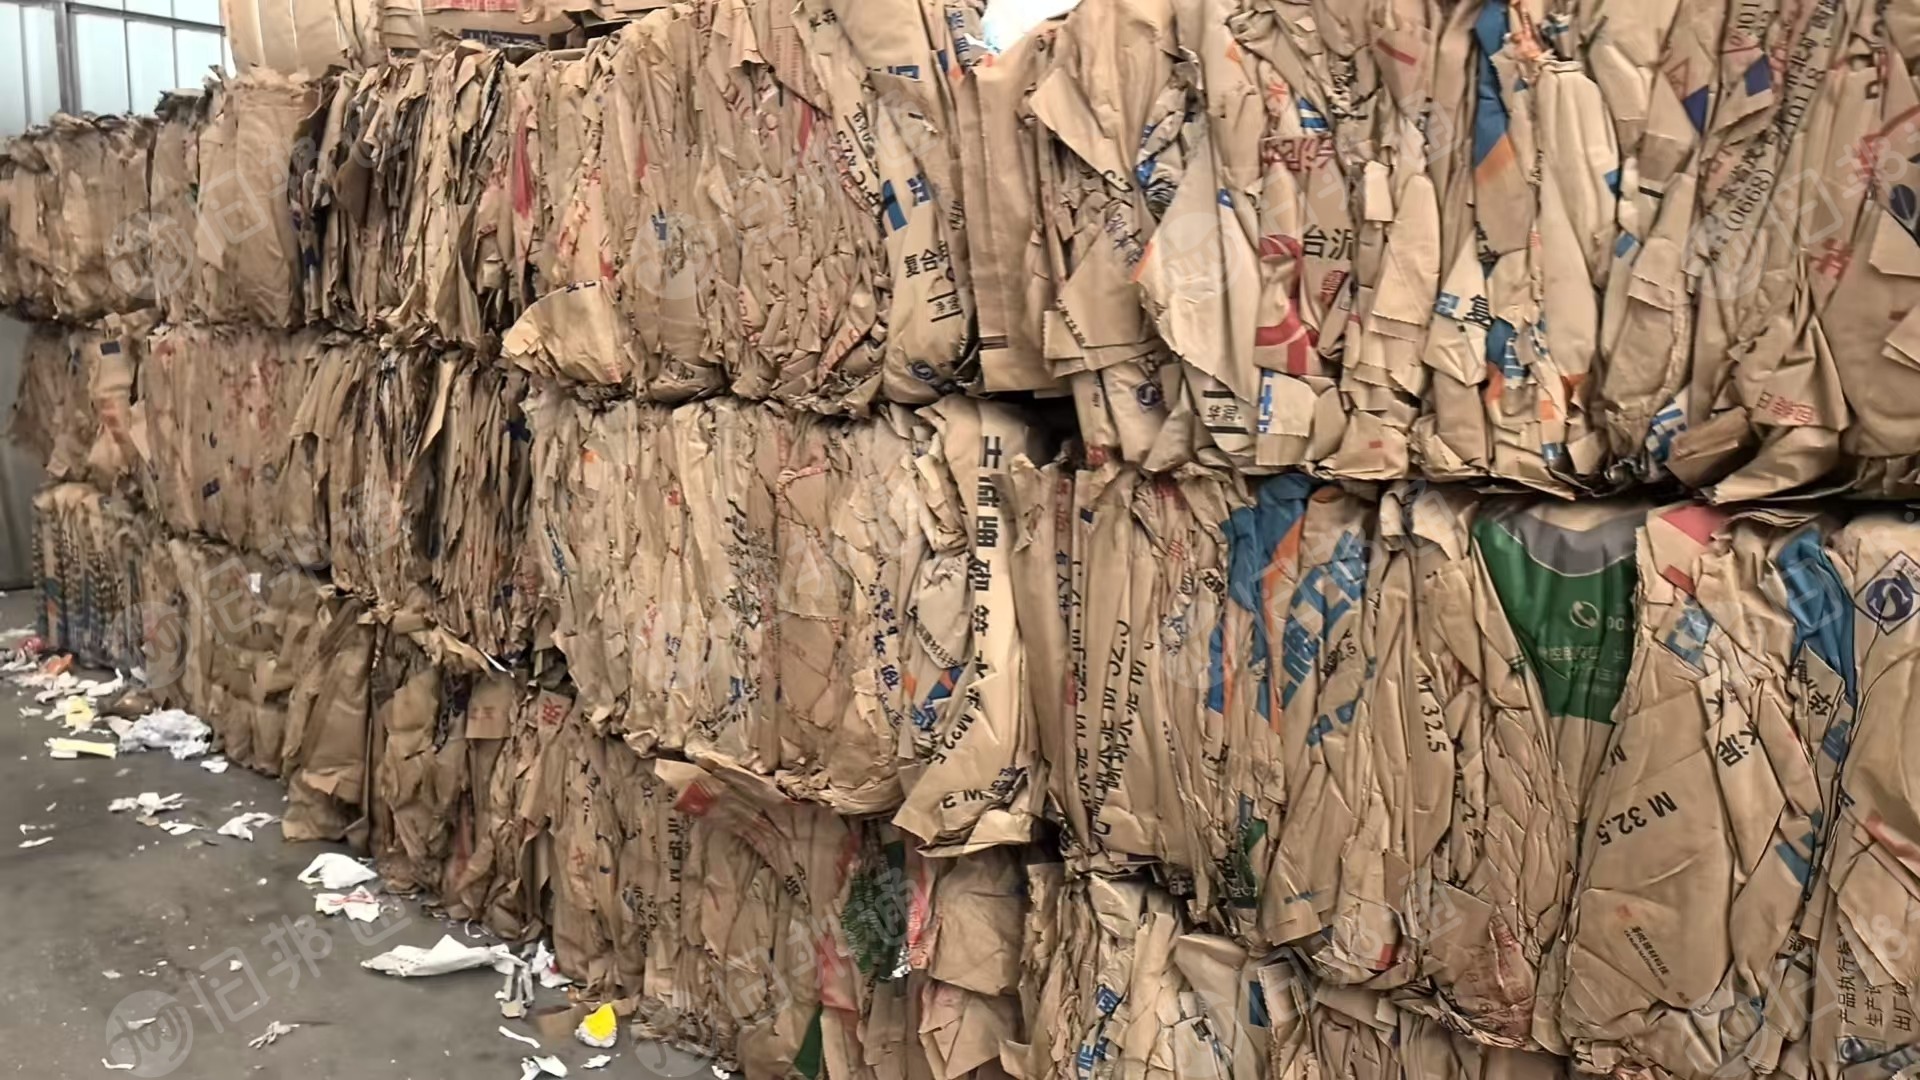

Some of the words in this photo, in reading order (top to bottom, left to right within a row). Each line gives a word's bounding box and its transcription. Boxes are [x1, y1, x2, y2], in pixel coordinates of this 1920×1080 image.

[1416, 675, 1433, 694] M
[1420, 705, 1447, 753] 32.5
[1647, 791, 1678, 818] M
[1596, 806, 1648, 847] 32.5
